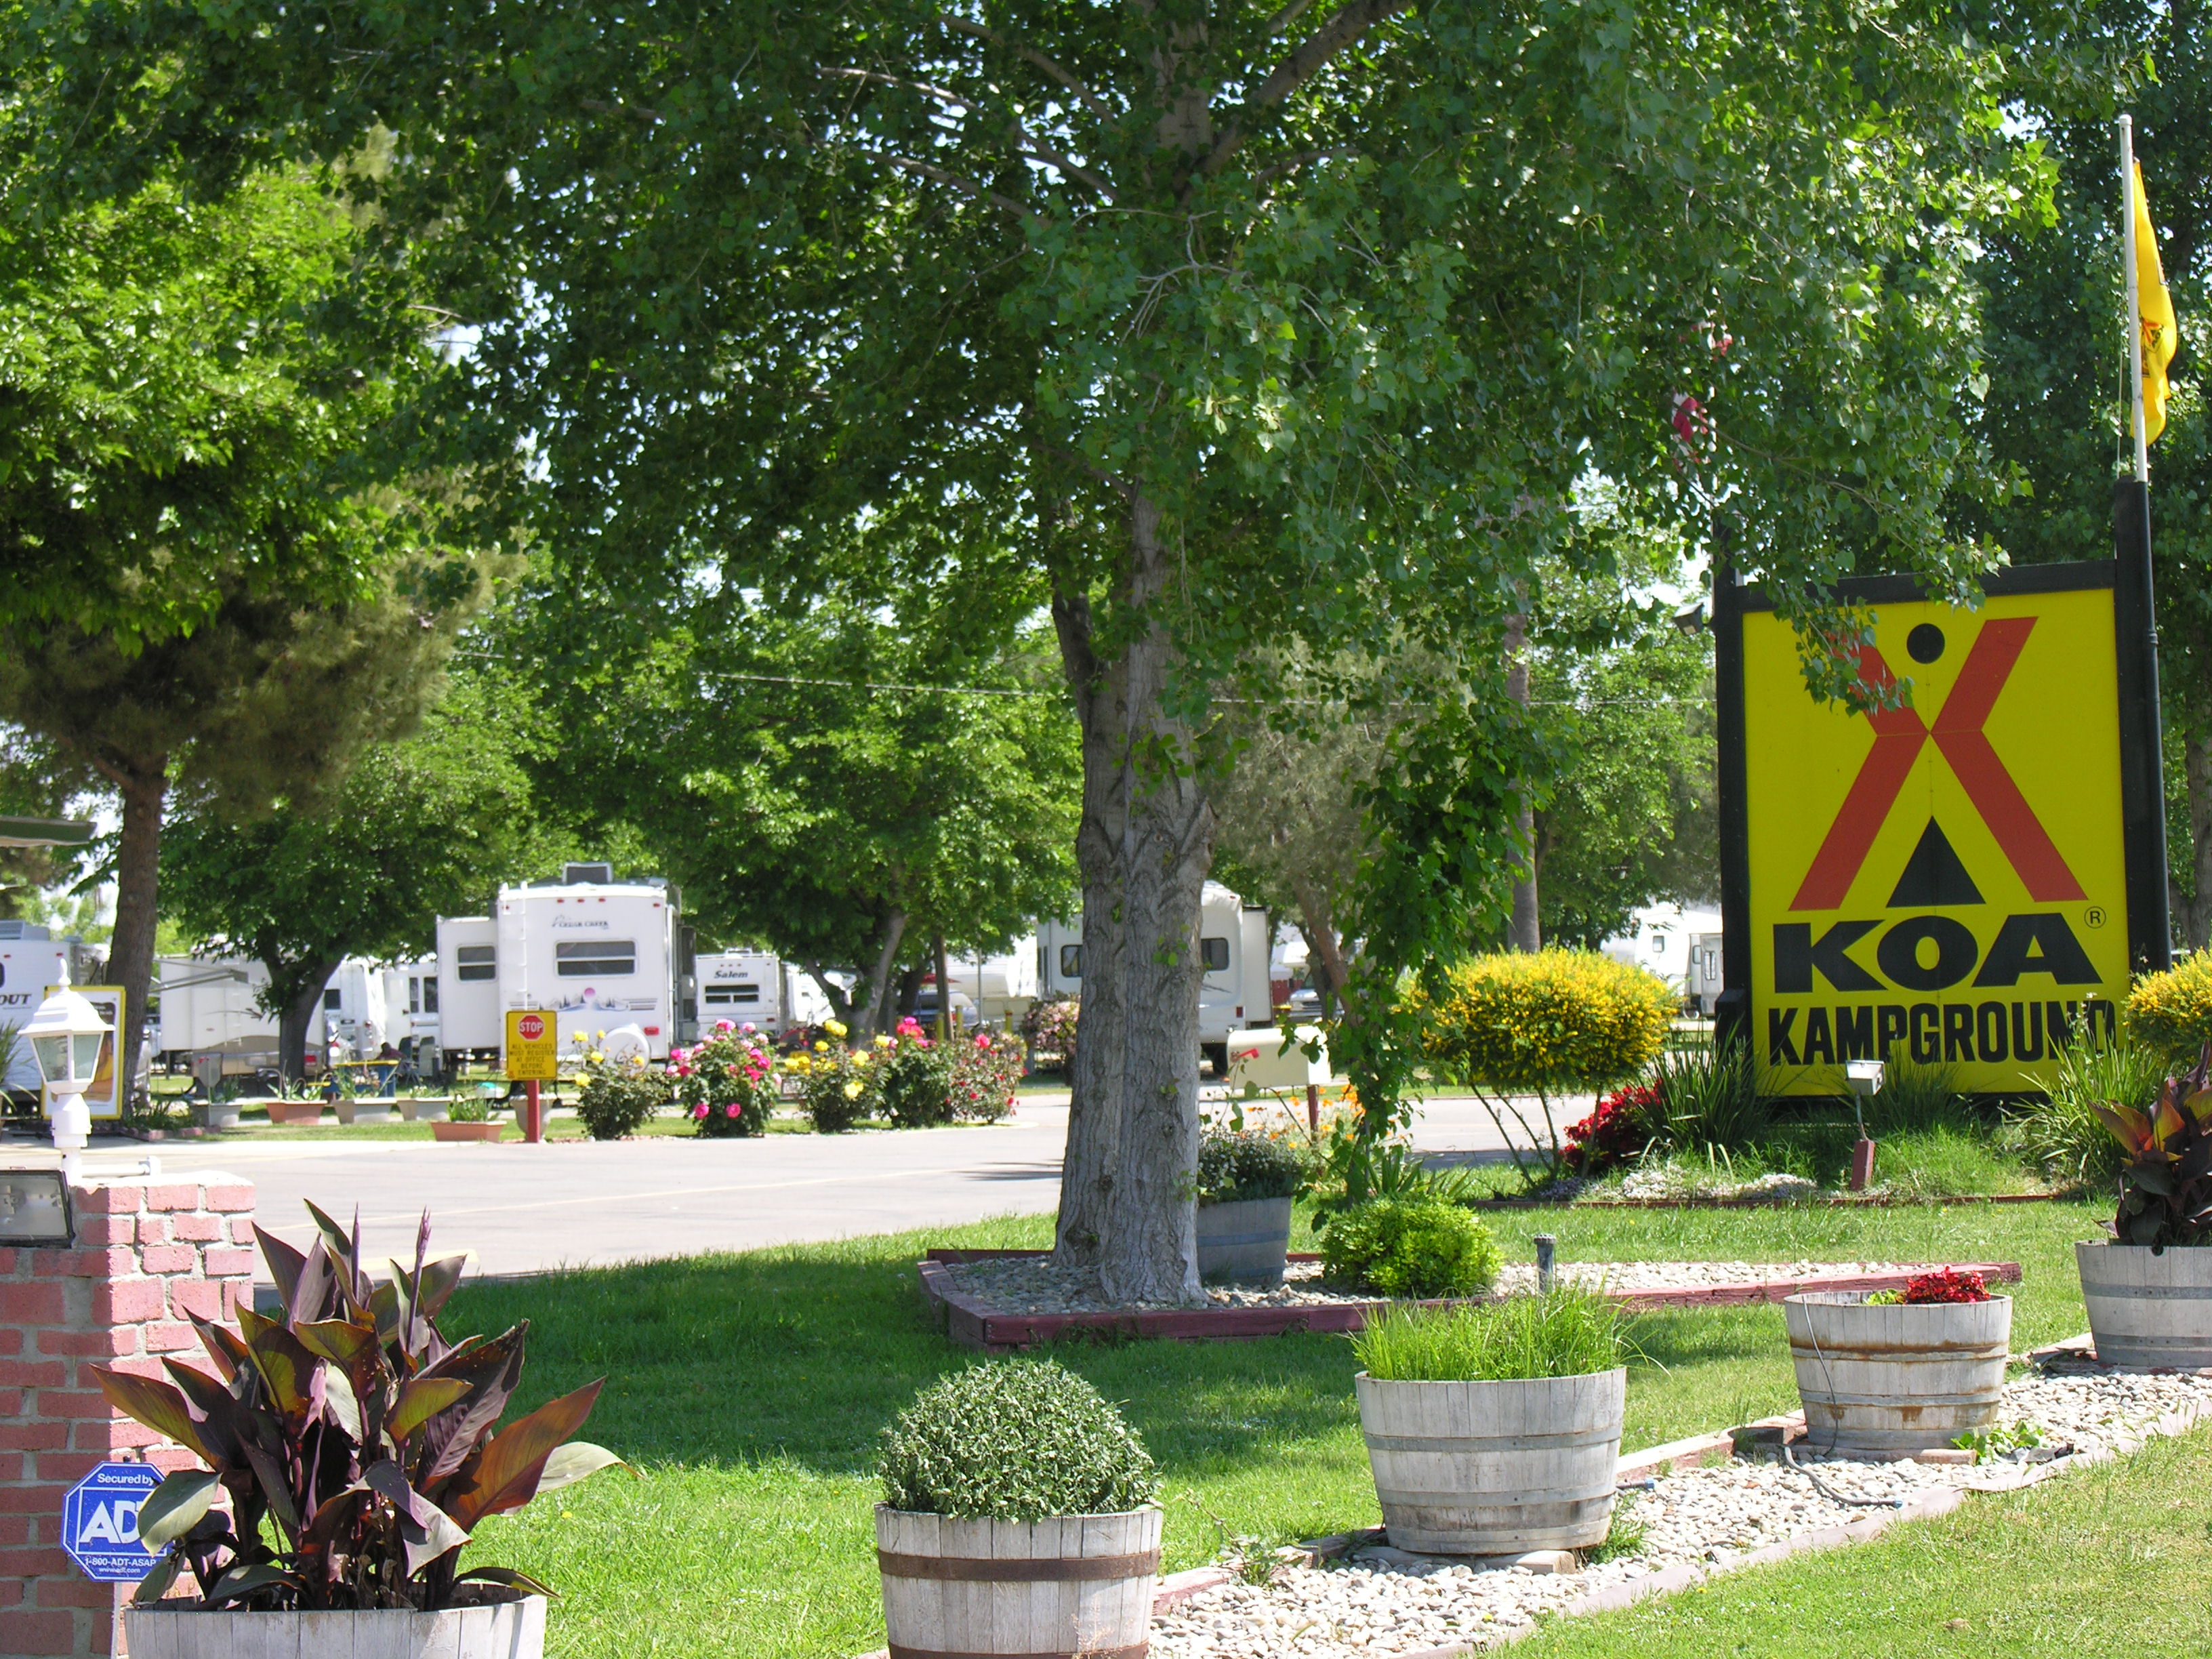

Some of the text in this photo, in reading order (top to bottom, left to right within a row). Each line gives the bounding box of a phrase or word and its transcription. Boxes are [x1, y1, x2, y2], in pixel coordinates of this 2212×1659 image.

[1773, 912, 2104, 994] KOA
[714, 970, 749, 979] Salem
[519, 1021, 543, 1033] STOP
[1768, 1000, 2116, 1065] KAMPGROUND
[97, 1473, 155, 1486] Secured by
[79, 1500, 144, 1544] AD
[85, 1557, 157, 1567] 1-800-ADT-ASAP
